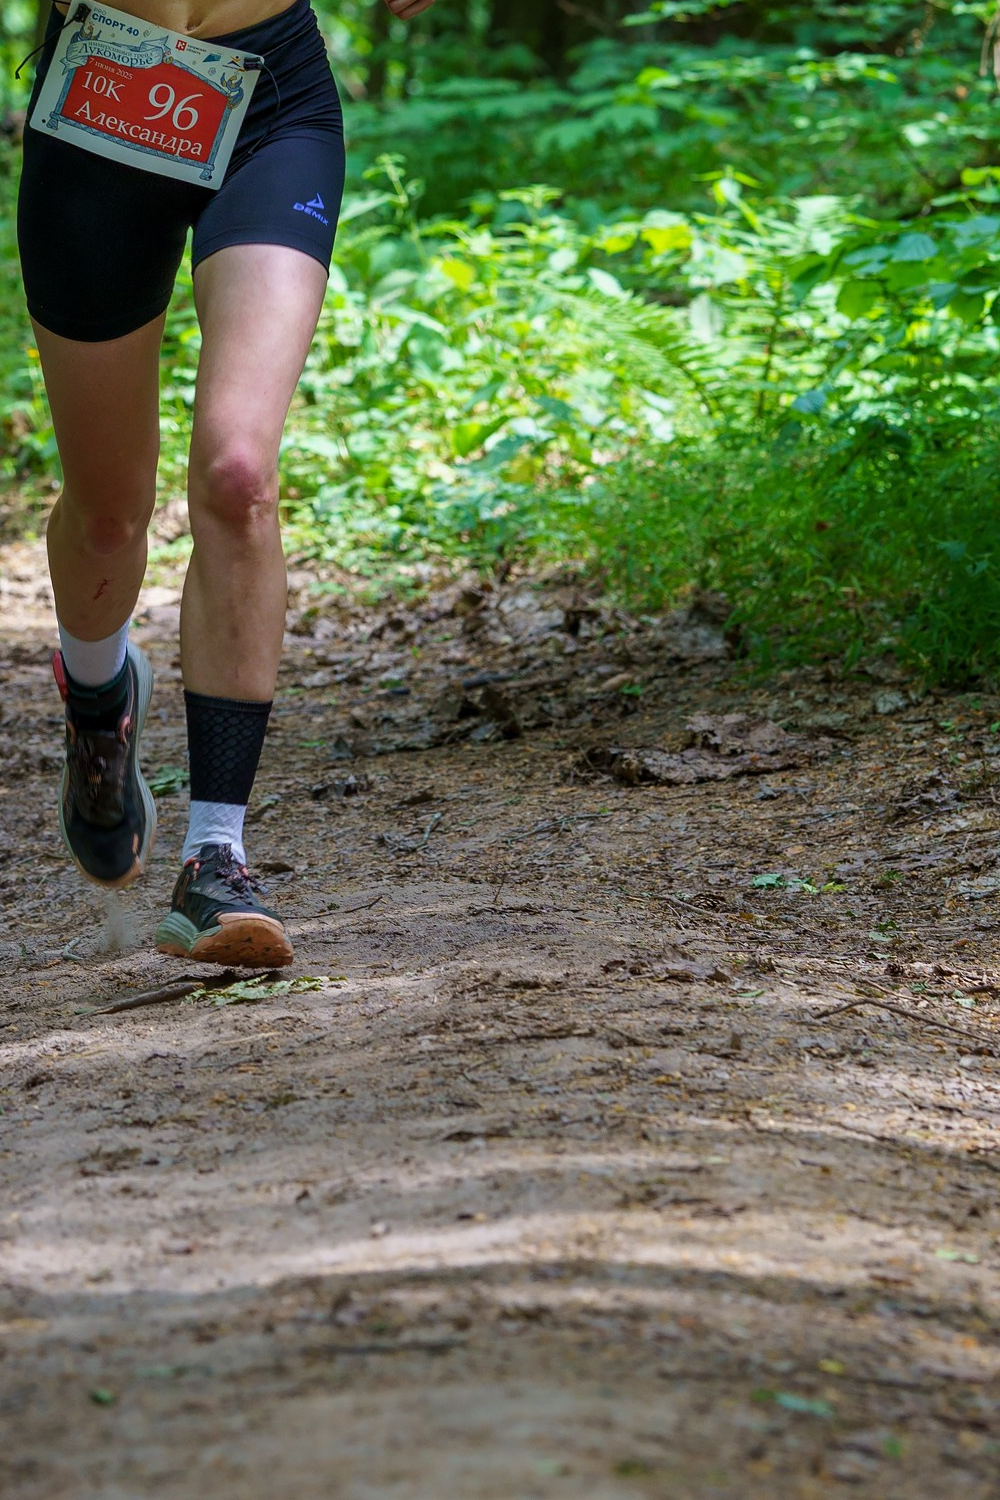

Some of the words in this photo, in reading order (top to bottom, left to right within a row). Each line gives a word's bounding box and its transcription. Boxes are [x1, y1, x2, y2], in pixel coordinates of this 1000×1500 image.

[92, 12, 126, 31] СПОРТ
[126, 26, 140, 37] 40
[78, 43, 153, 68] Лукоморье
[95, 60, 115, 74] июня
[116, 68, 133, 80] 2025
[143, 83, 203, 131] 96
[74, 100, 203, 156] Александра
[293, 202, 329, 227] DEMIX
